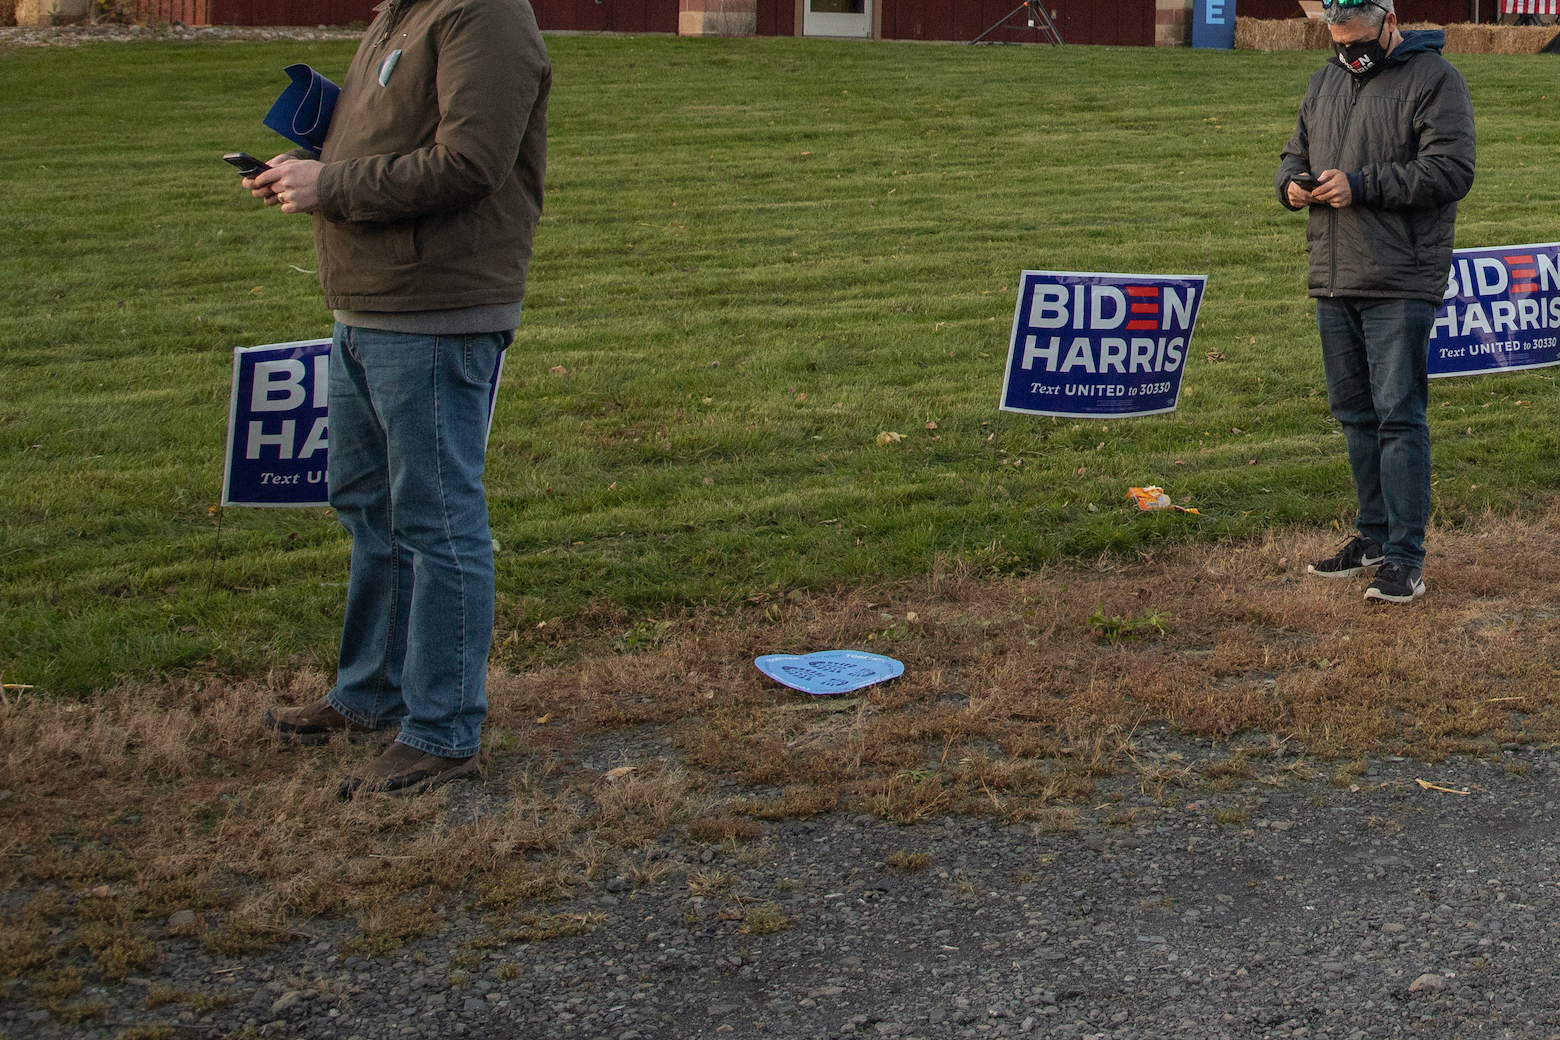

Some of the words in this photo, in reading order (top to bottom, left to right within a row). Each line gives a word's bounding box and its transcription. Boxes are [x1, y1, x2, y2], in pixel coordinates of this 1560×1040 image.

[1028, 283, 1196, 331] BIDEN
[1021, 334, 1185, 374] HARRIS
[1439, 347, 1465, 359] Text
[1469, 340, 1521, 356] UNITED
[1523, 342, 1531, 351] to
[1532, 337, 1557, 350] 30330
[1030, 382, 1061, 396] Text
[1065, 384, 1126, 397] UNITED
[1128, 386, 1138, 396] to
[1139, 381, 1171, 396] 30330
[260, 472, 301, 485] Text
